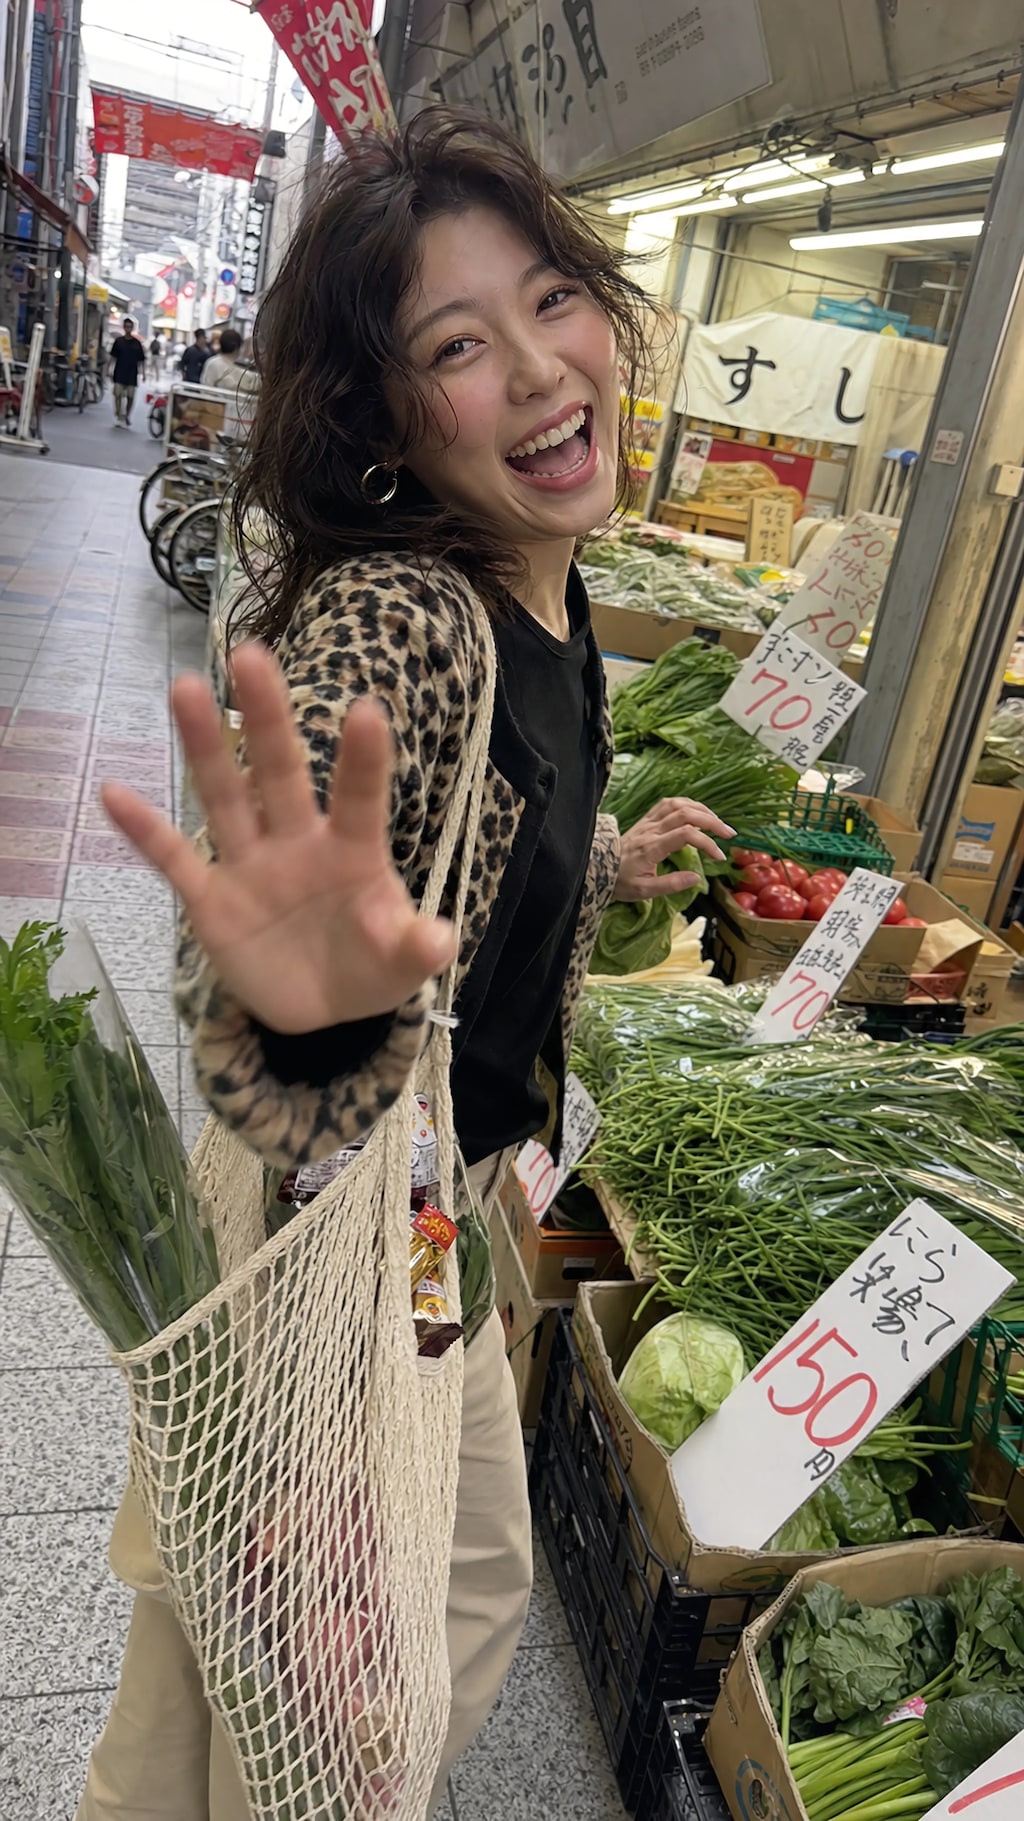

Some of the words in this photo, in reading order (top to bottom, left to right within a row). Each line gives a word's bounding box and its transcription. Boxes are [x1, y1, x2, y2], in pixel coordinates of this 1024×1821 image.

[718, 345, 867, 424] すし
[744, 668, 812, 730] 70
[771, 970, 829, 1030] 70
[754, 1318, 878, 1448] 150
